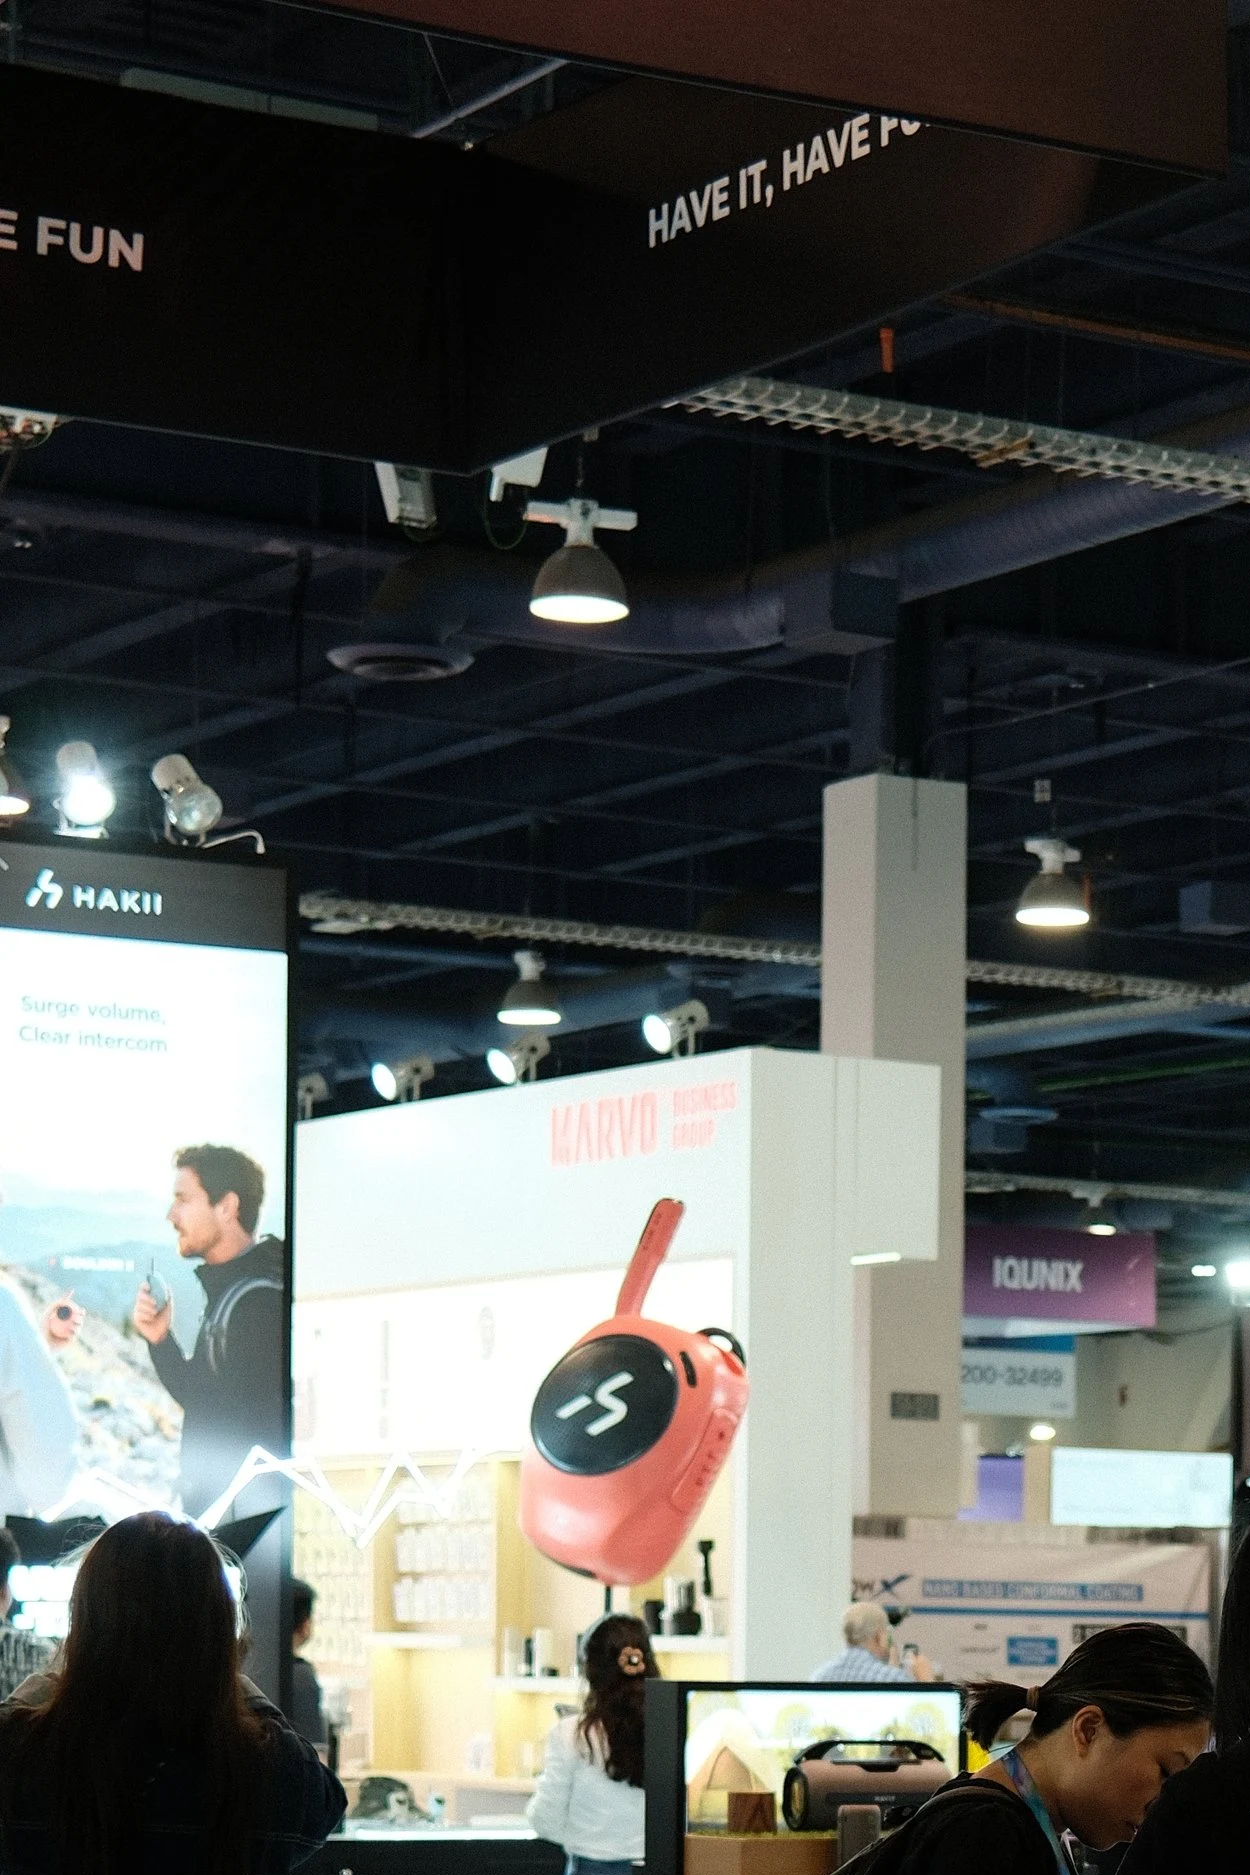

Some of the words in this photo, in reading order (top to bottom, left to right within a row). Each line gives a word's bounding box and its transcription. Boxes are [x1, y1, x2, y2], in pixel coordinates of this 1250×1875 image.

[649, 176, 730, 249] HAVE
[739, 159, 774, 208] IT,
[783, 113, 871, 192] HAVE
[37, 216, 144, 272] FUN
[72, 884, 163, 916] HAKII
[21, 995, 80, 1018] Surge
[19, 1025, 71, 1047] Clear
[78, 1030, 168, 1053] intercom
[992, 1257, 1084, 1293] IQUNIX
